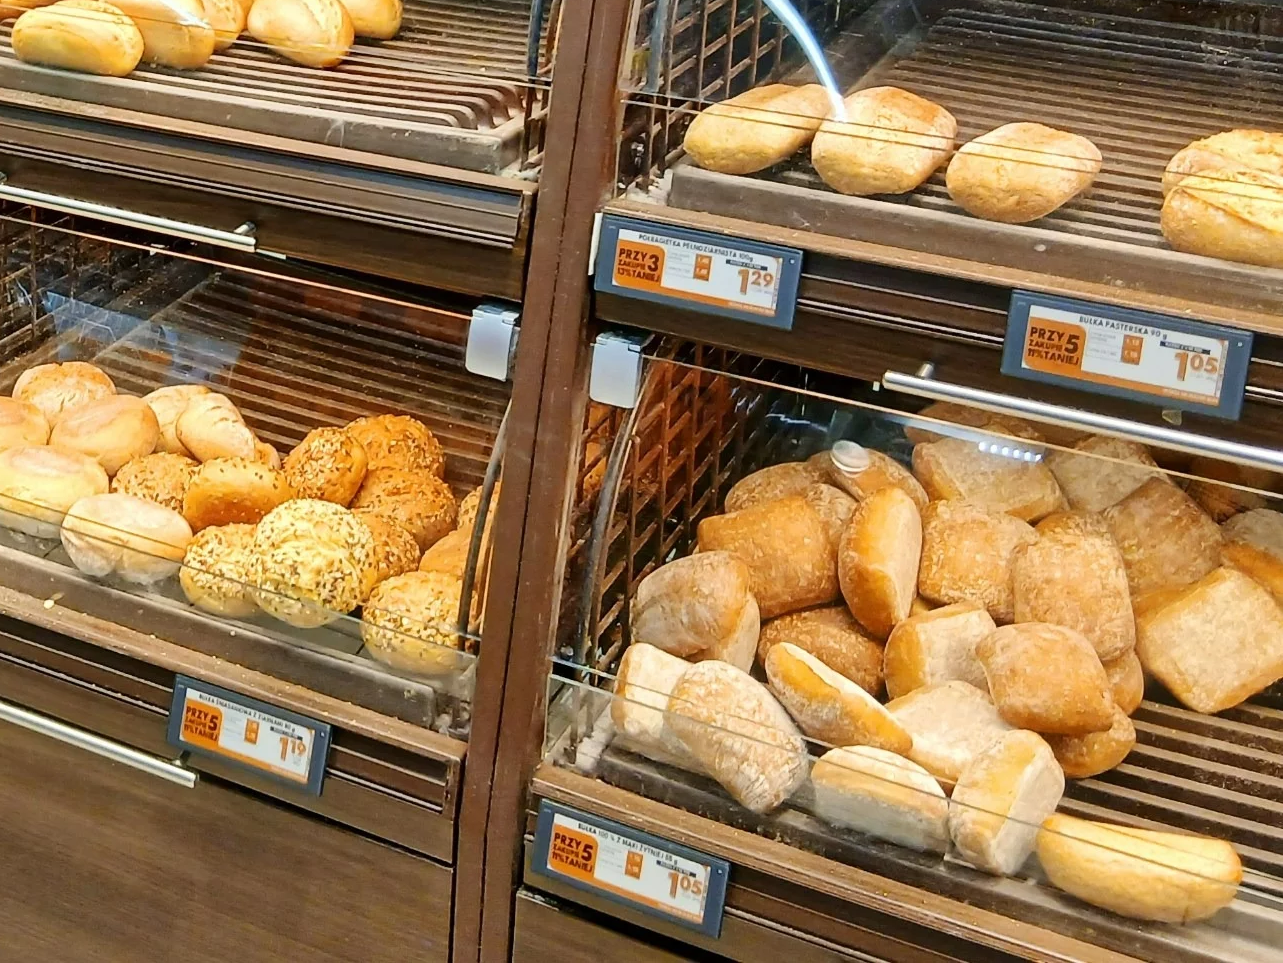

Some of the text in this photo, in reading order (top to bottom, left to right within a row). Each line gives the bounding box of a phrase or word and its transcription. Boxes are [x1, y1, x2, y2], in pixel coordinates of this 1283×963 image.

[619, 246, 660, 273] PRZY 3
[1078, 315, 1104, 329] BUŁKA
[1104, 320, 1148, 337] PASTERSKA
[1029, 326, 1080, 356] PRZY 5
[186, 705, 219, 732] PRZY 5
[553, 831, 594, 863] PRZY 5
